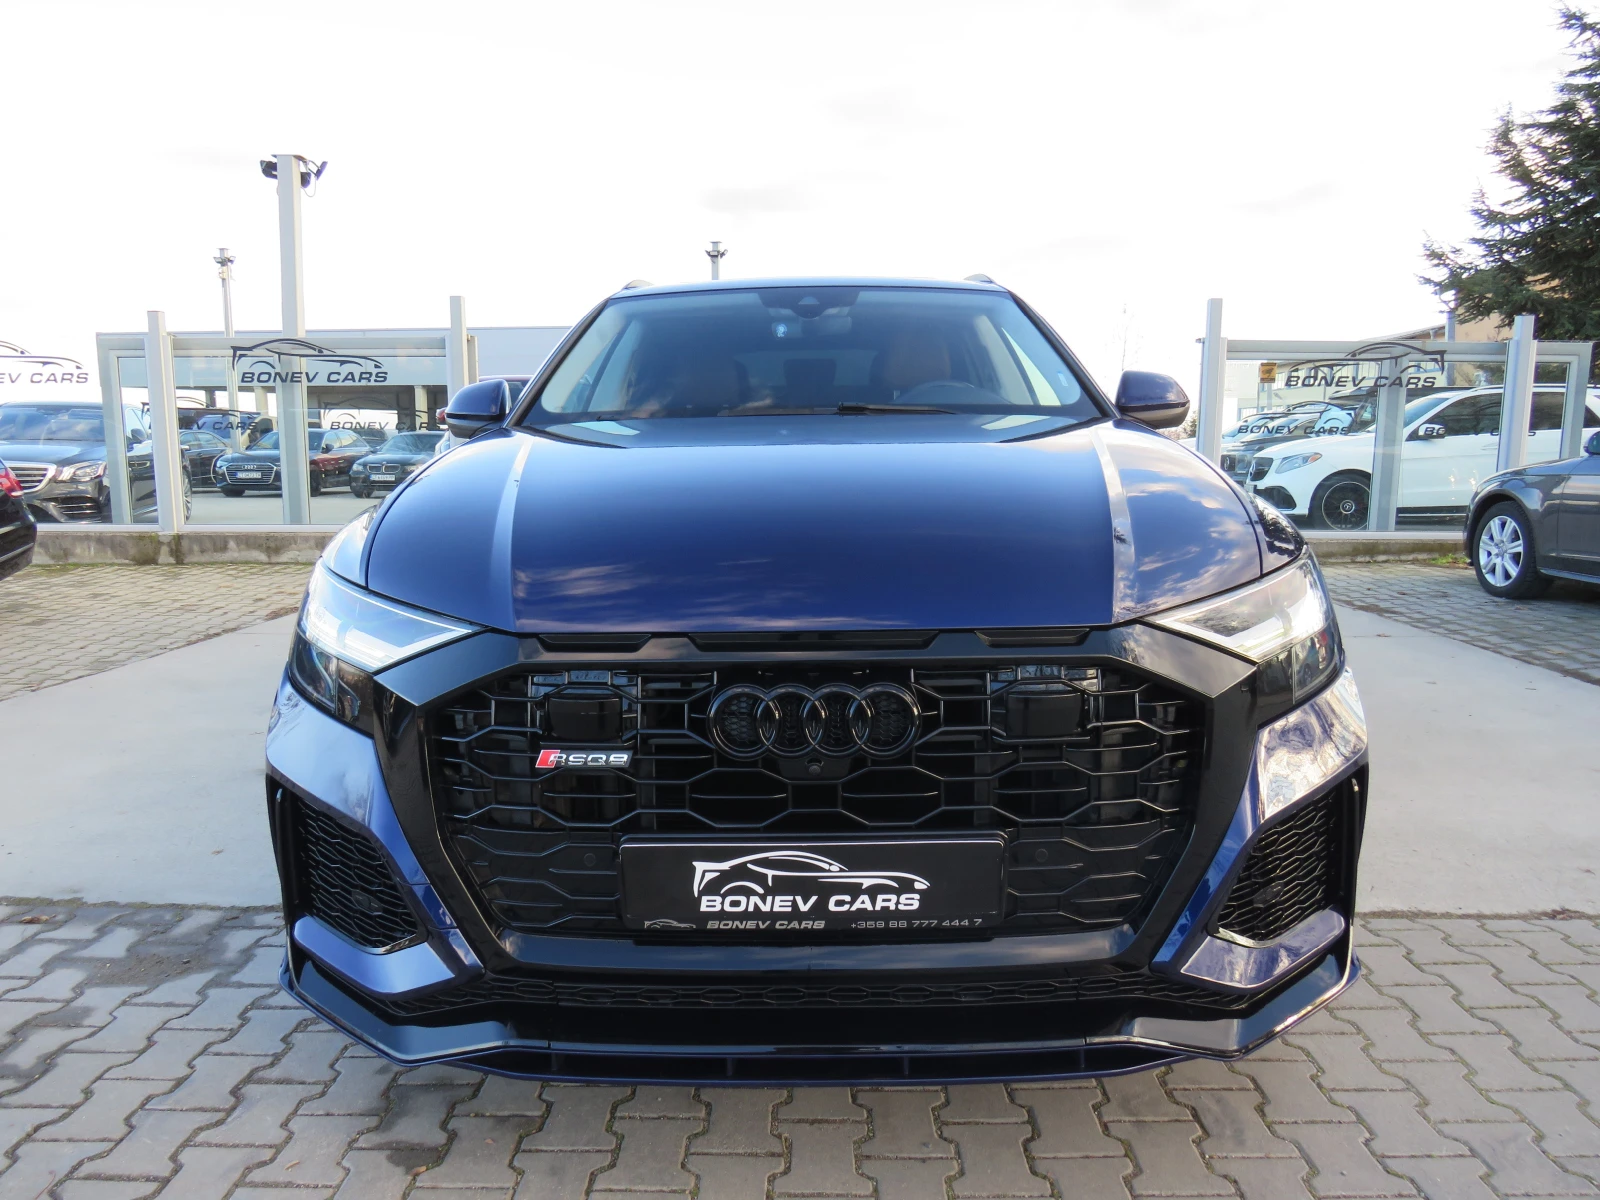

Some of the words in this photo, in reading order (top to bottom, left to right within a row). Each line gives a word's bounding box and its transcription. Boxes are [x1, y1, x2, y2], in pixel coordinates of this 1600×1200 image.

[30, 372, 89, 384] CARS
[240, 371, 319, 383] BONEV
[326, 371, 388, 383] CARS
[1285, 375, 1366, 388] BONEV
[1372, 376, 1437, 388] CARS
[213, 421, 258, 431] CARS
[330, 421, 389, 430] BONEV
[1237, 425, 1297, 435] BONEV
[1303, 426, 1351, 435] CARS
[547, 753, 629, 766] RSQ8
[699, 895, 819, 912] BONEV
[828, 893, 921, 912] CARS
[706, 920, 771, 929] BONEV
[774, 920, 826, 929] CARS
[850, 921, 885, 929] +359
[911, 920, 938, 928] 777
[941, 919, 969, 927] 444
[973, 918, 983, 926] 7
